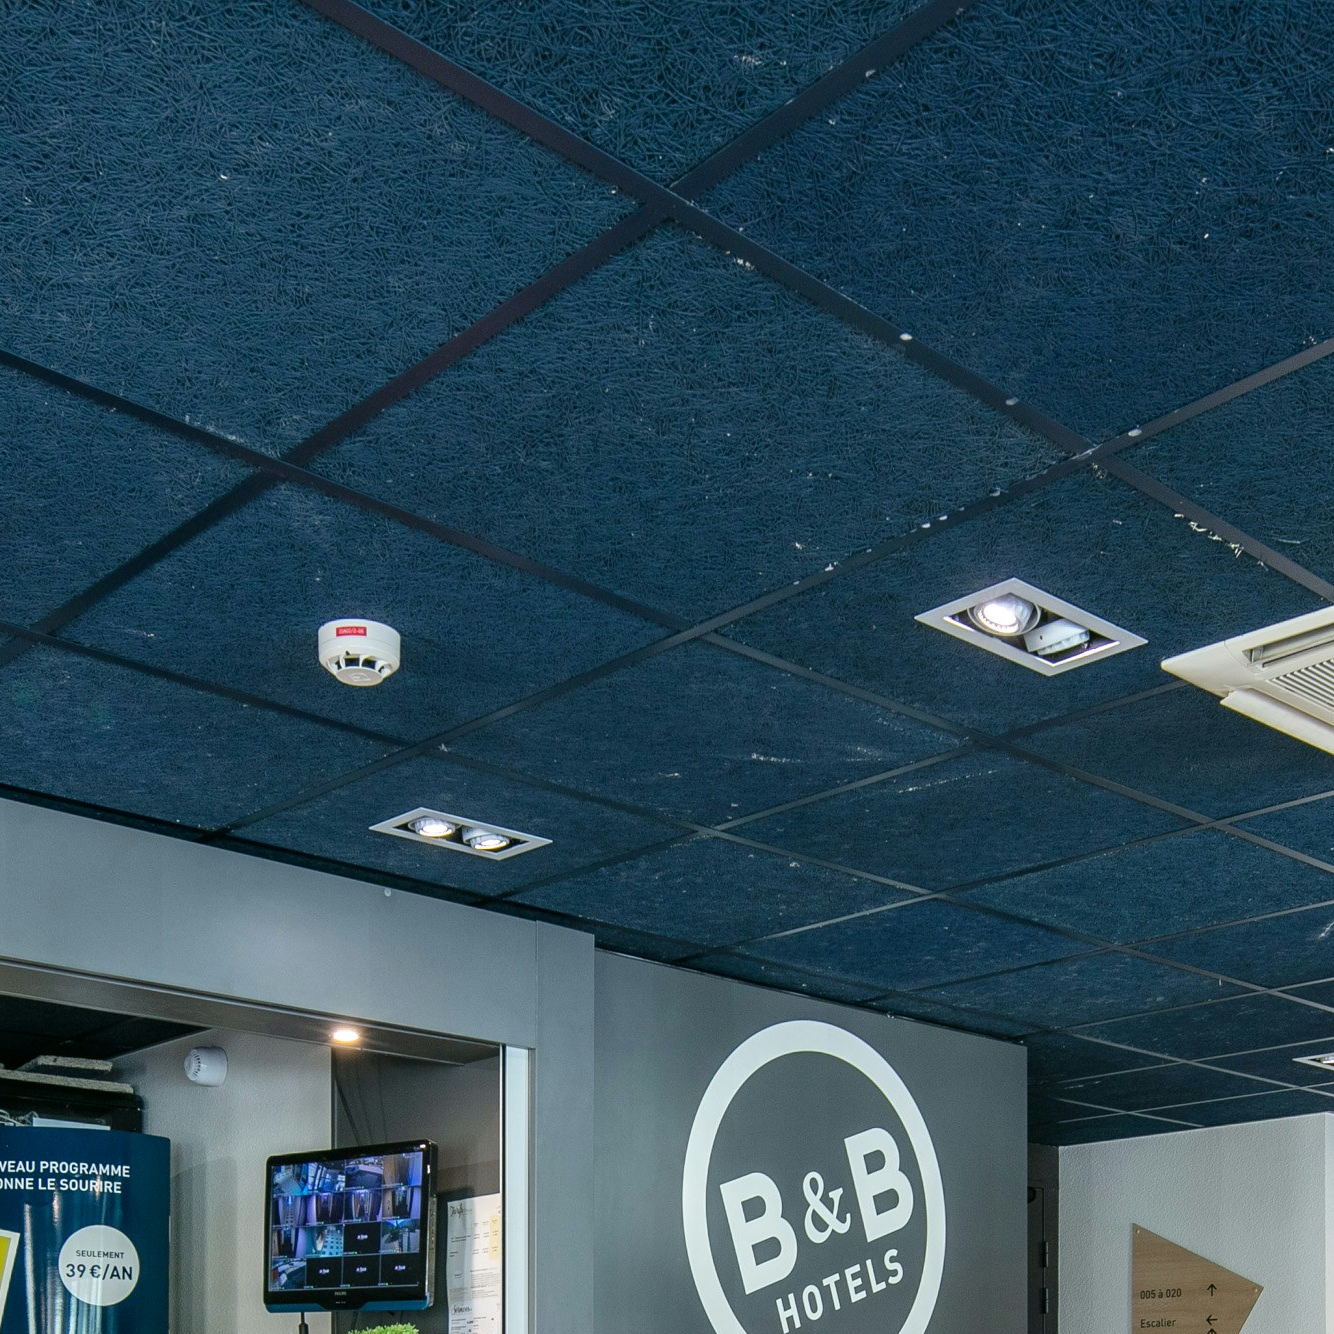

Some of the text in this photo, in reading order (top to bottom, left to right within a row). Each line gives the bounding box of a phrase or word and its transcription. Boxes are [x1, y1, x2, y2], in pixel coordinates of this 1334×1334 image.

[39, 1161, 130, 1177] PROGRAMME
[38, 1178, 56, 1190] LE
[59, 1179, 122, 1193] SOURIRE
[719, 1127, 914, 1295] B&B
[75, 1250, 125, 1259] SEULEMENT
[66, 1263, 86, 1278] 39
[775, 1248, 904, 1334] HOTELS
[1140, 1288, 1182, 1299] 005 à 020
[1140, 1318, 1177, 1328] Escalier
